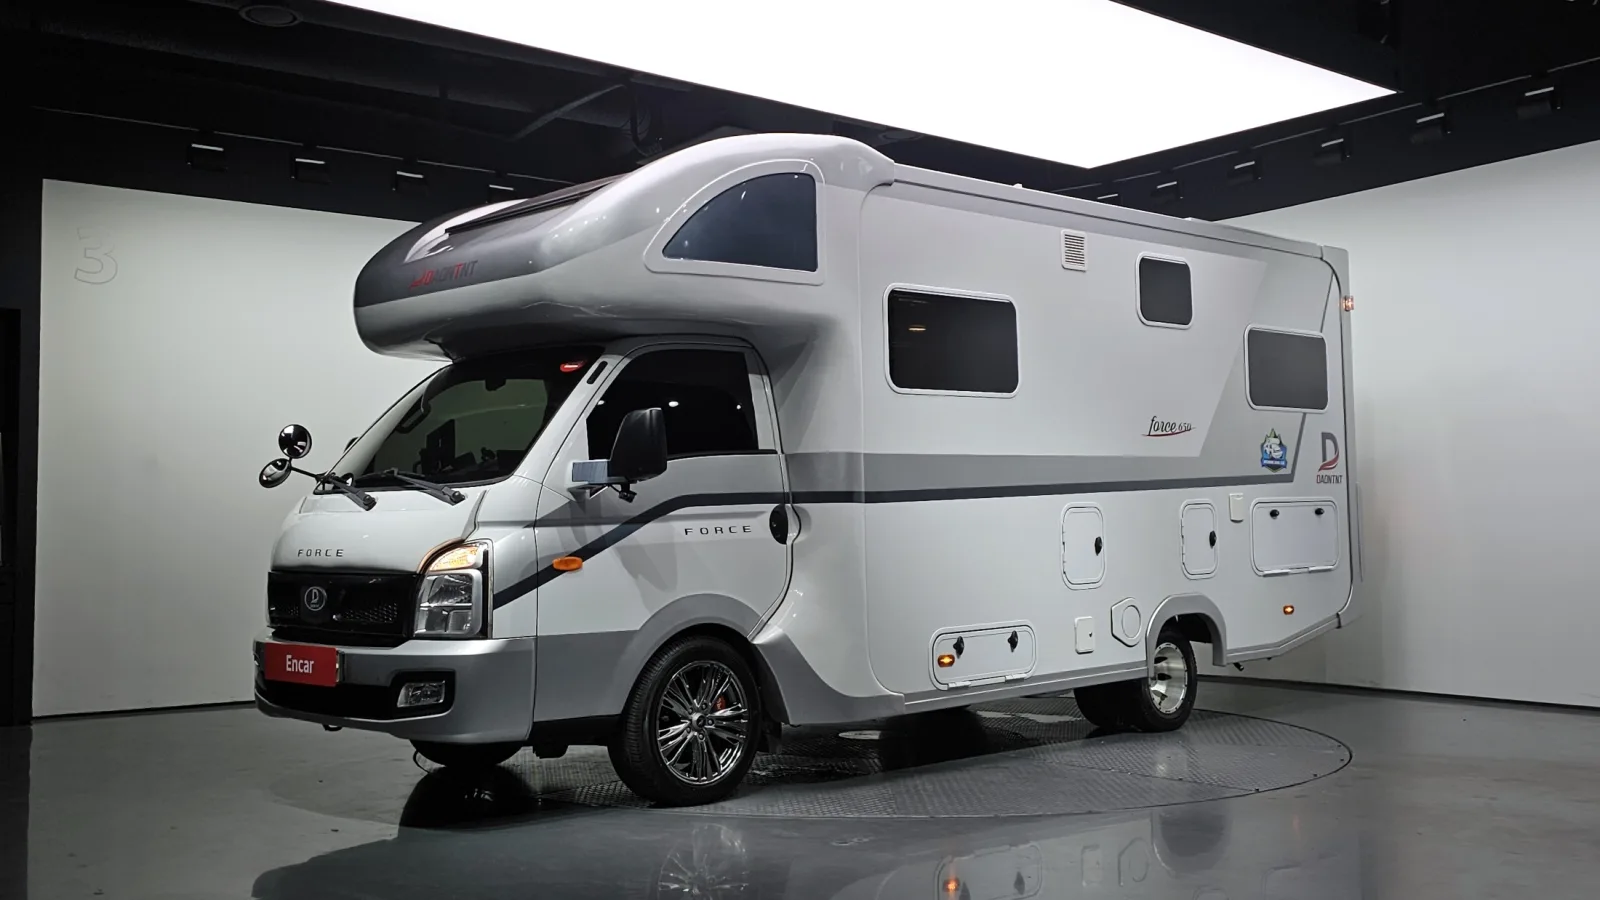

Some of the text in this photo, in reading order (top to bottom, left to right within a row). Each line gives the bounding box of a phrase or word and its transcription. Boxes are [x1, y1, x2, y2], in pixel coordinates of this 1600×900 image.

[74, 225, 119, 285] 3
[1147, 415, 1177, 436] force
[684, 525, 752, 536] FORCE
[297, 548, 344, 557] FORCE
[286, 654, 315, 674] Encar
